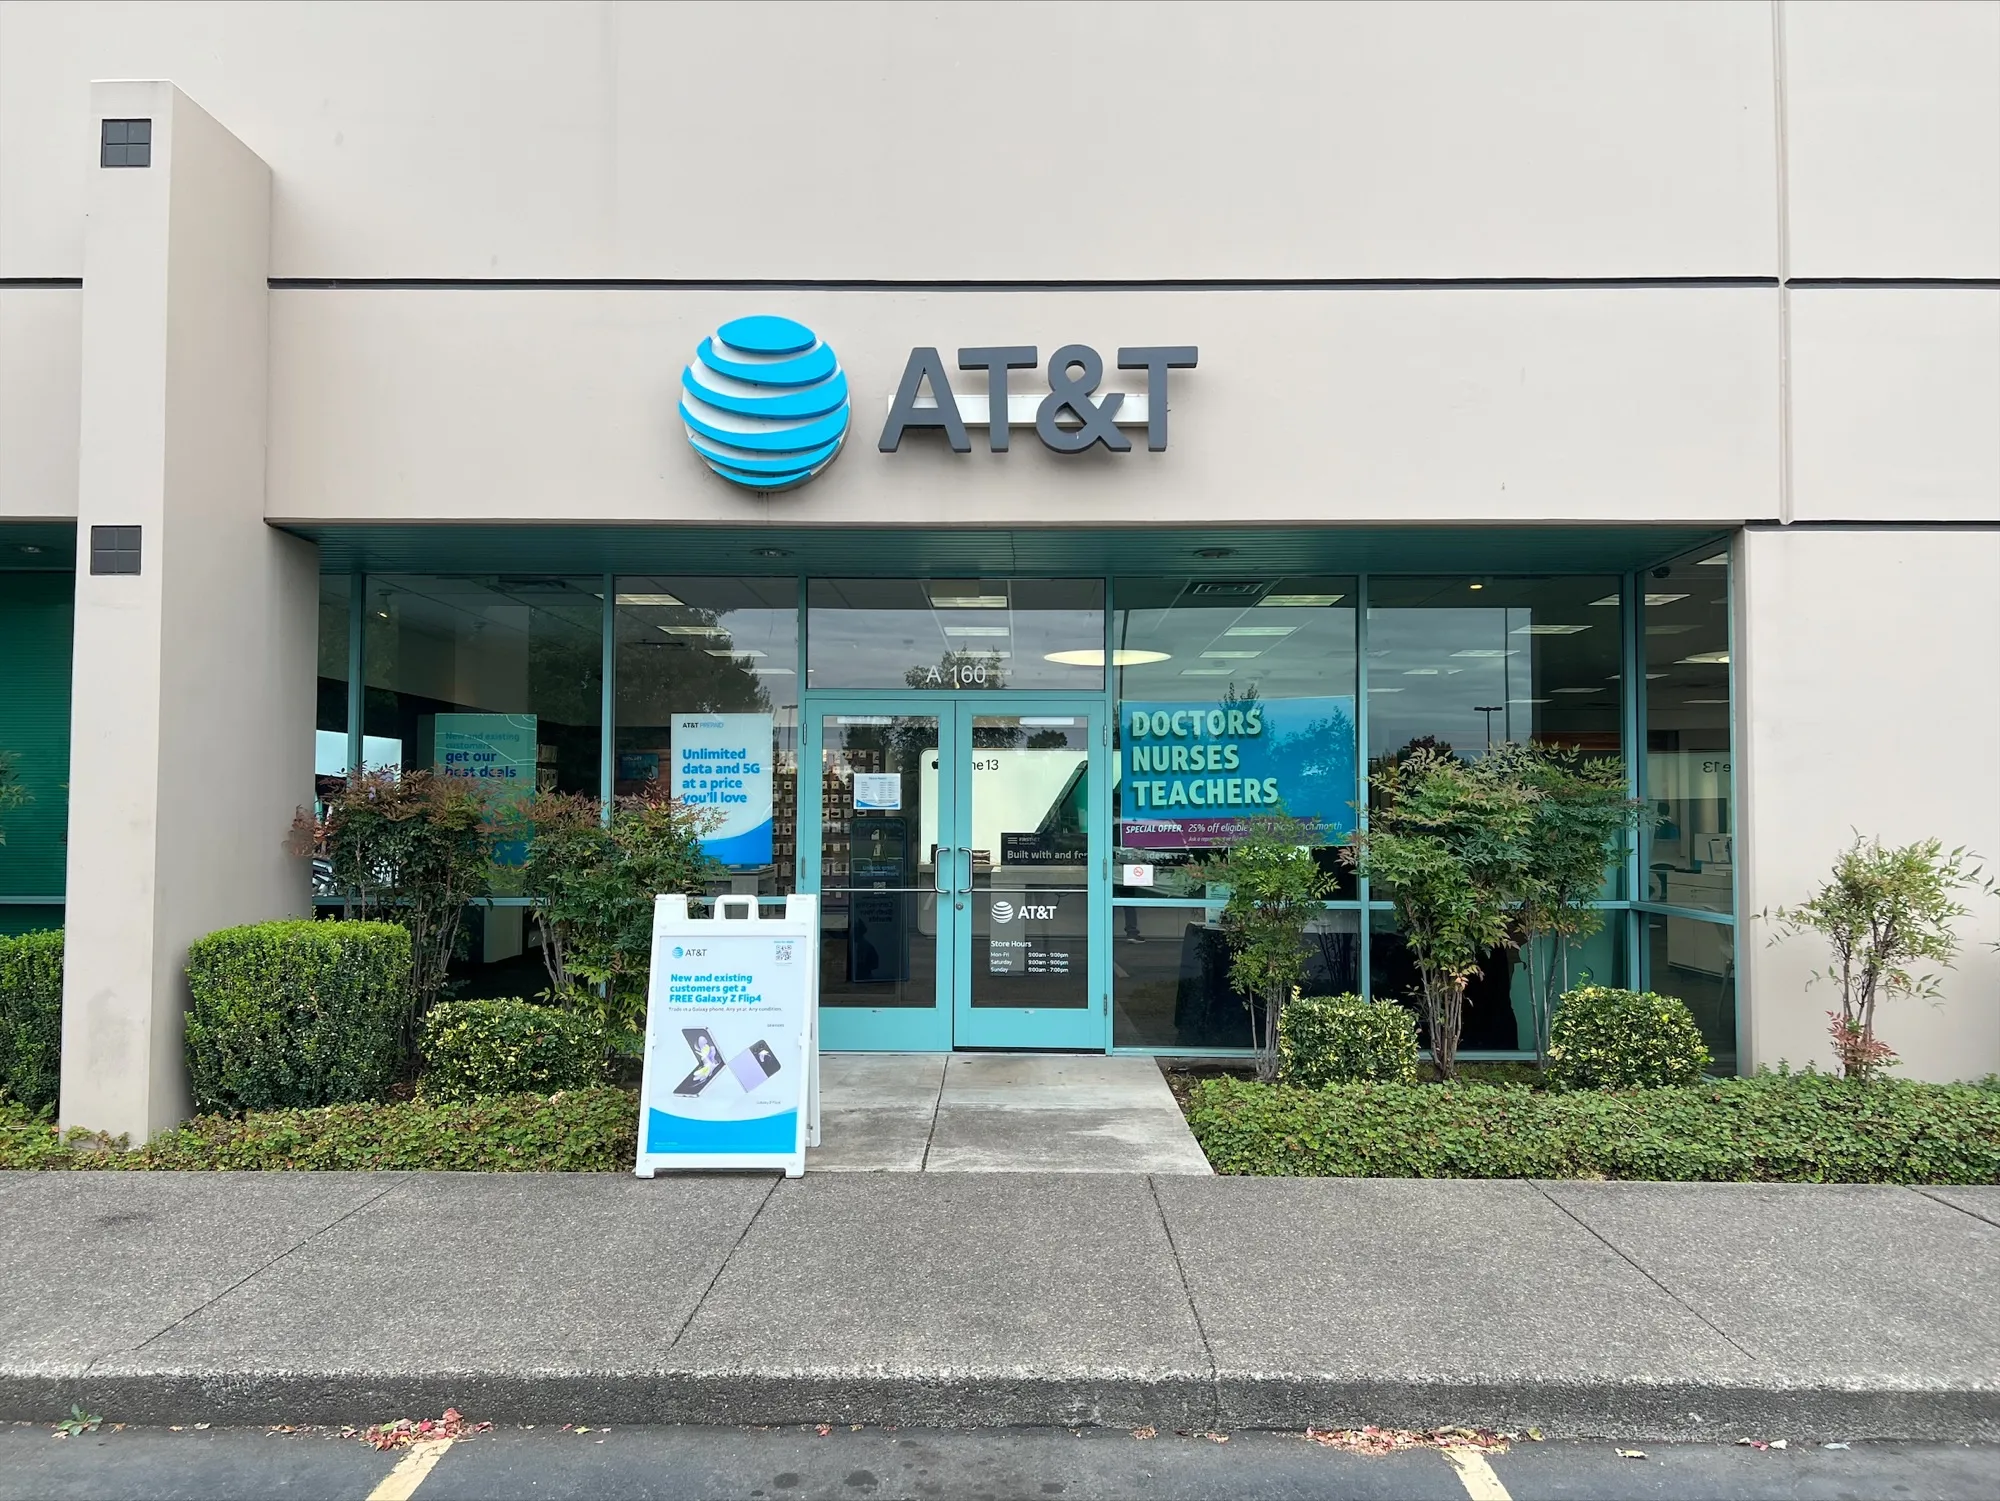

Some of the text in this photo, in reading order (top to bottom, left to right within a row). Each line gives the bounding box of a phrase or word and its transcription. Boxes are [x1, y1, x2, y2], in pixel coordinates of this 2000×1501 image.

[878, 344, 1198, 453] AT&T
[925, 665, 986, 684] A 160
[1132, 708, 1262, 738] DOCTORS
[485, 732, 520, 742] existing
[445, 751, 497, 765] get our
[682, 748, 746, 760] Unlimited
[1132, 744, 1240, 772] NURSES
[682, 763, 760, 774] data and 5G
[985, 759, 999, 771] 13
[479, 765, 517, 778] deals
[682, 778, 743, 791] at a price
[721, 791, 747, 803] love
[1132, 777, 1279, 806] TEACHERS
[1125, 824, 1156, 835] SPECIAL
[1188, 823, 1206, 834] 25%
[1207, 822, 1220, 834] off
[1007, 850, 1028, 859] Built
[1031, 850, 1052, 859] with
[1054, 850, 1071, 859] and
[1017, 905, 1057, 920] AT&T
[990, 940, 1032, 948] Store Hours
[685, 949, 708, 957] AT&T
[671, 973, 753, 984] New and existing
[670, 985, 720, 993] customers
[722, 985, 739, 994] get
[669, 994, 762, 1005] FREE Galaxy Z Flip4
